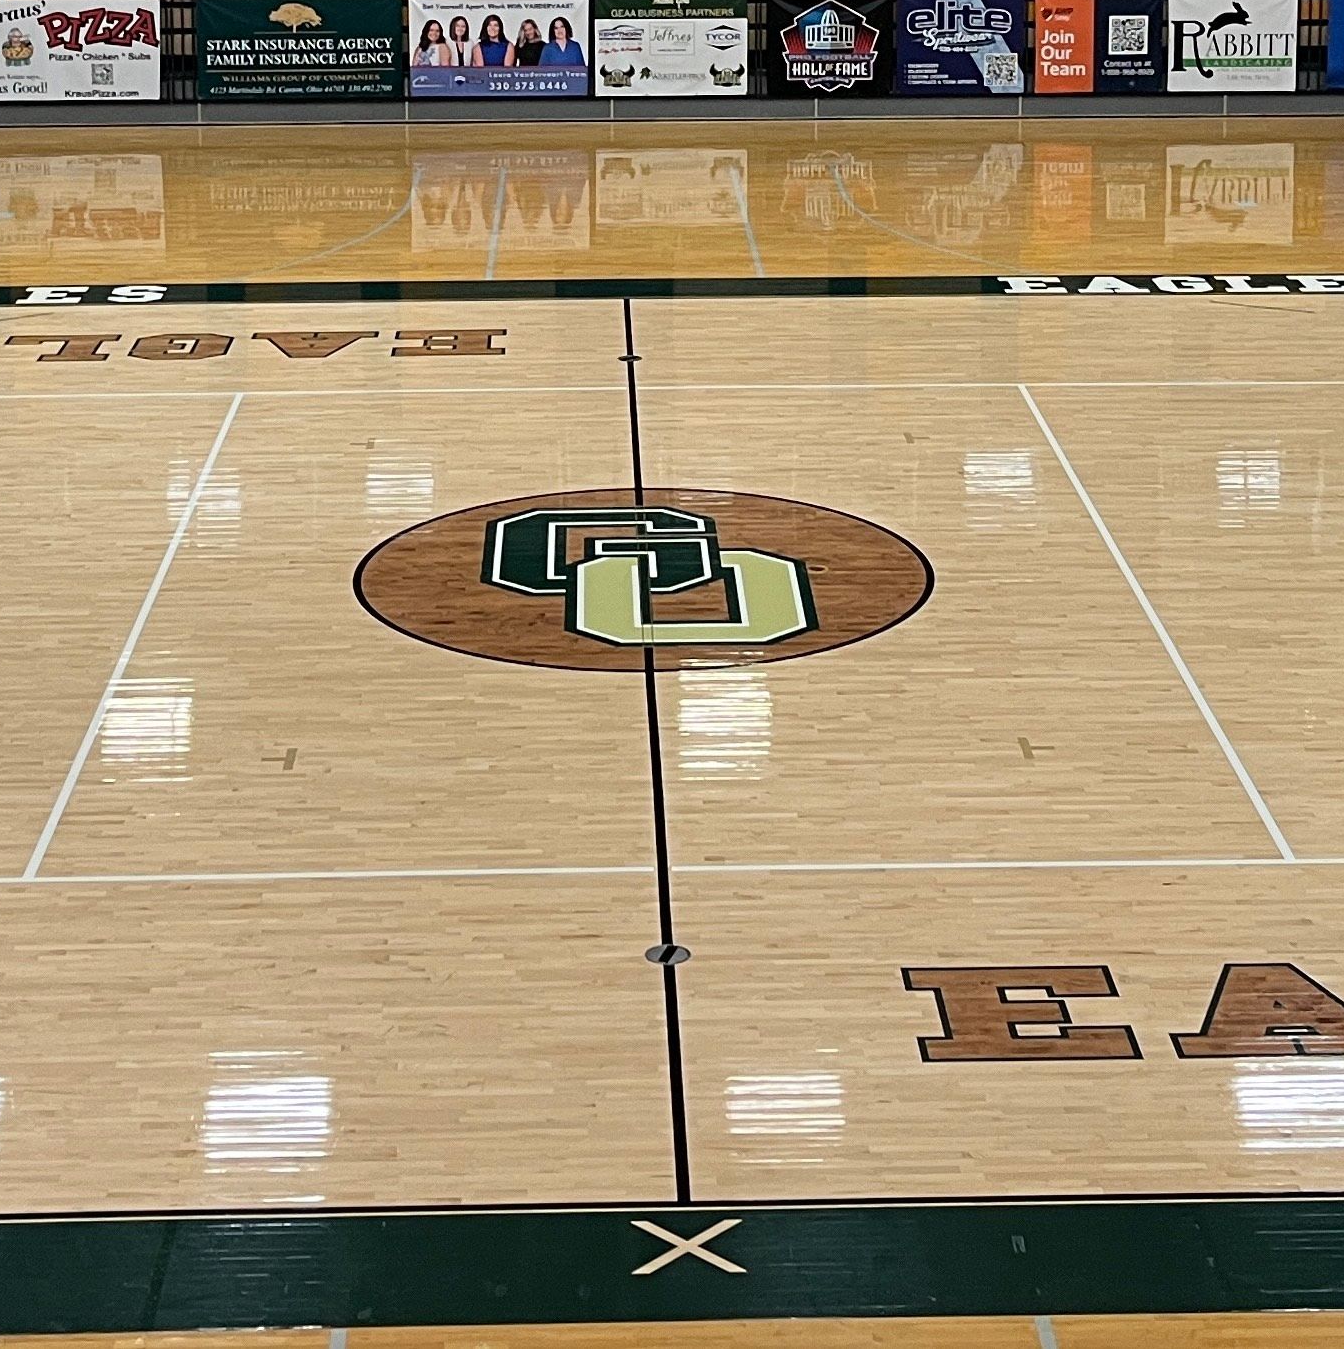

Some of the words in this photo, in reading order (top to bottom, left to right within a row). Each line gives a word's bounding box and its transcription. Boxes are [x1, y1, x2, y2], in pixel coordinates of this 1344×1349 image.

[638, 8, 683, 17] BUSINESS
[686, 8, 735, 17] PARTNERS
[907, 0, 1012, 34] elite
[37, 7, 160, 53] PIZZA
[705, 33, 741, 41] TYCOR
[1041, 29, 1075, 45] Join
[207, 39, 251, 51] STARK
[254, 38, 334, 51] INSURANCE
[337, 37, 392, 50] AGENCY
[49, 53, 74, 61] Pizza
[82, 53, 119, 61] Chicken
[128, 52, 151, 61] Subs
[207, 54, 256, 66] FAMILY
[259, 53, 337, 65] INSURANCE
[340, 52, 394, 65] AGENCY
[1041, 46, 1073, 61] Our
[792, 62, 826, 76] HALL
[835, 62, 868, 76] FAME
[1041, 61, 1086, 76] Team
[324, 74, 380, 82] COMPANIES
[12, 81, 48, 94] Good!
